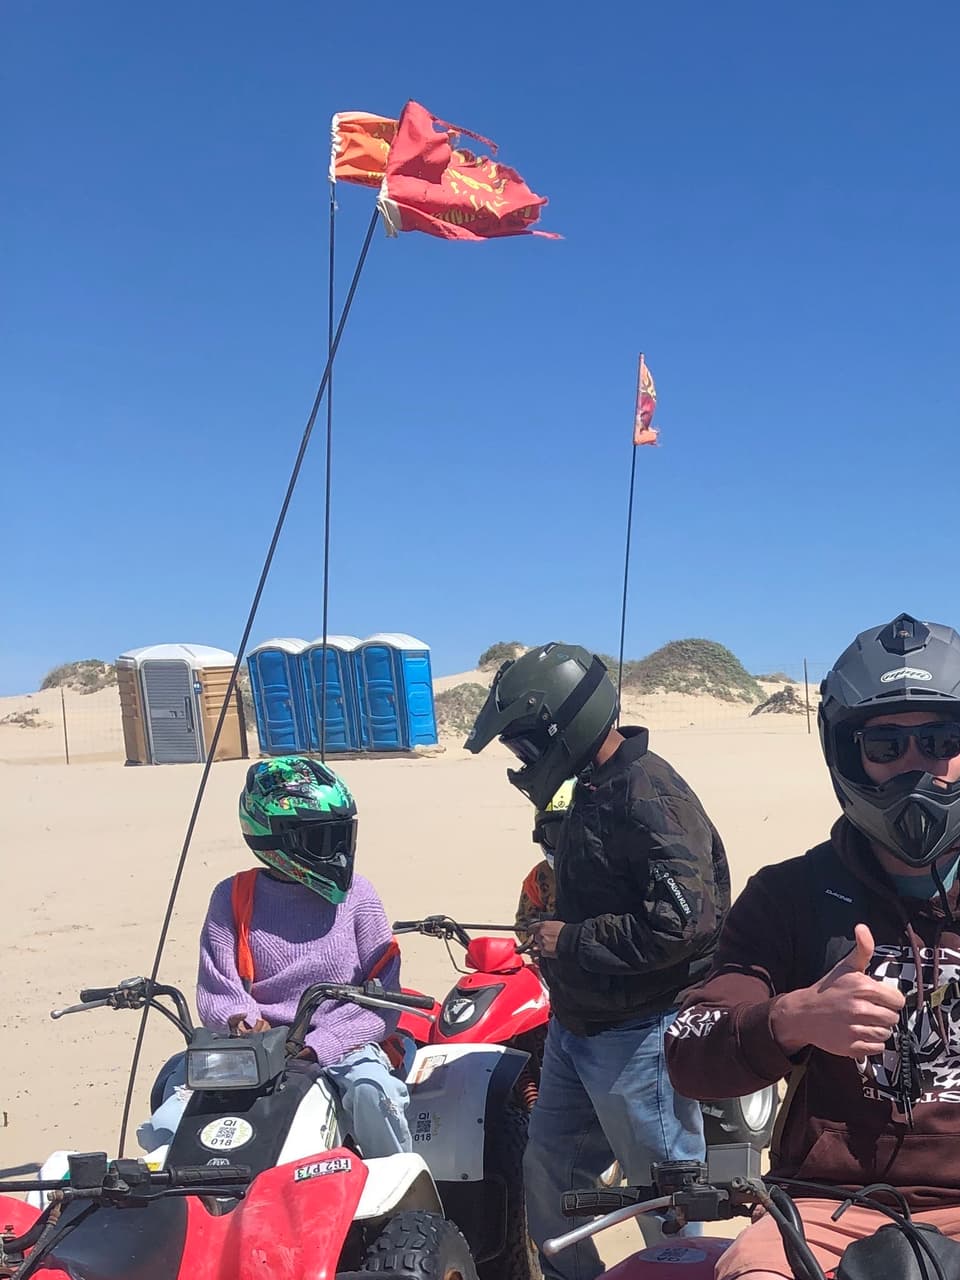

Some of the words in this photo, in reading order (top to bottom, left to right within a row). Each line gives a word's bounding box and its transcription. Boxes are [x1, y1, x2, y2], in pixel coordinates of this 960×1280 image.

[667, 878, 683, 899] CALVIN
[679, 898, 691, 914] KLEIN
[223, 1119, 237, 1127] QI
[211, 1137, 232, 1146] 018
